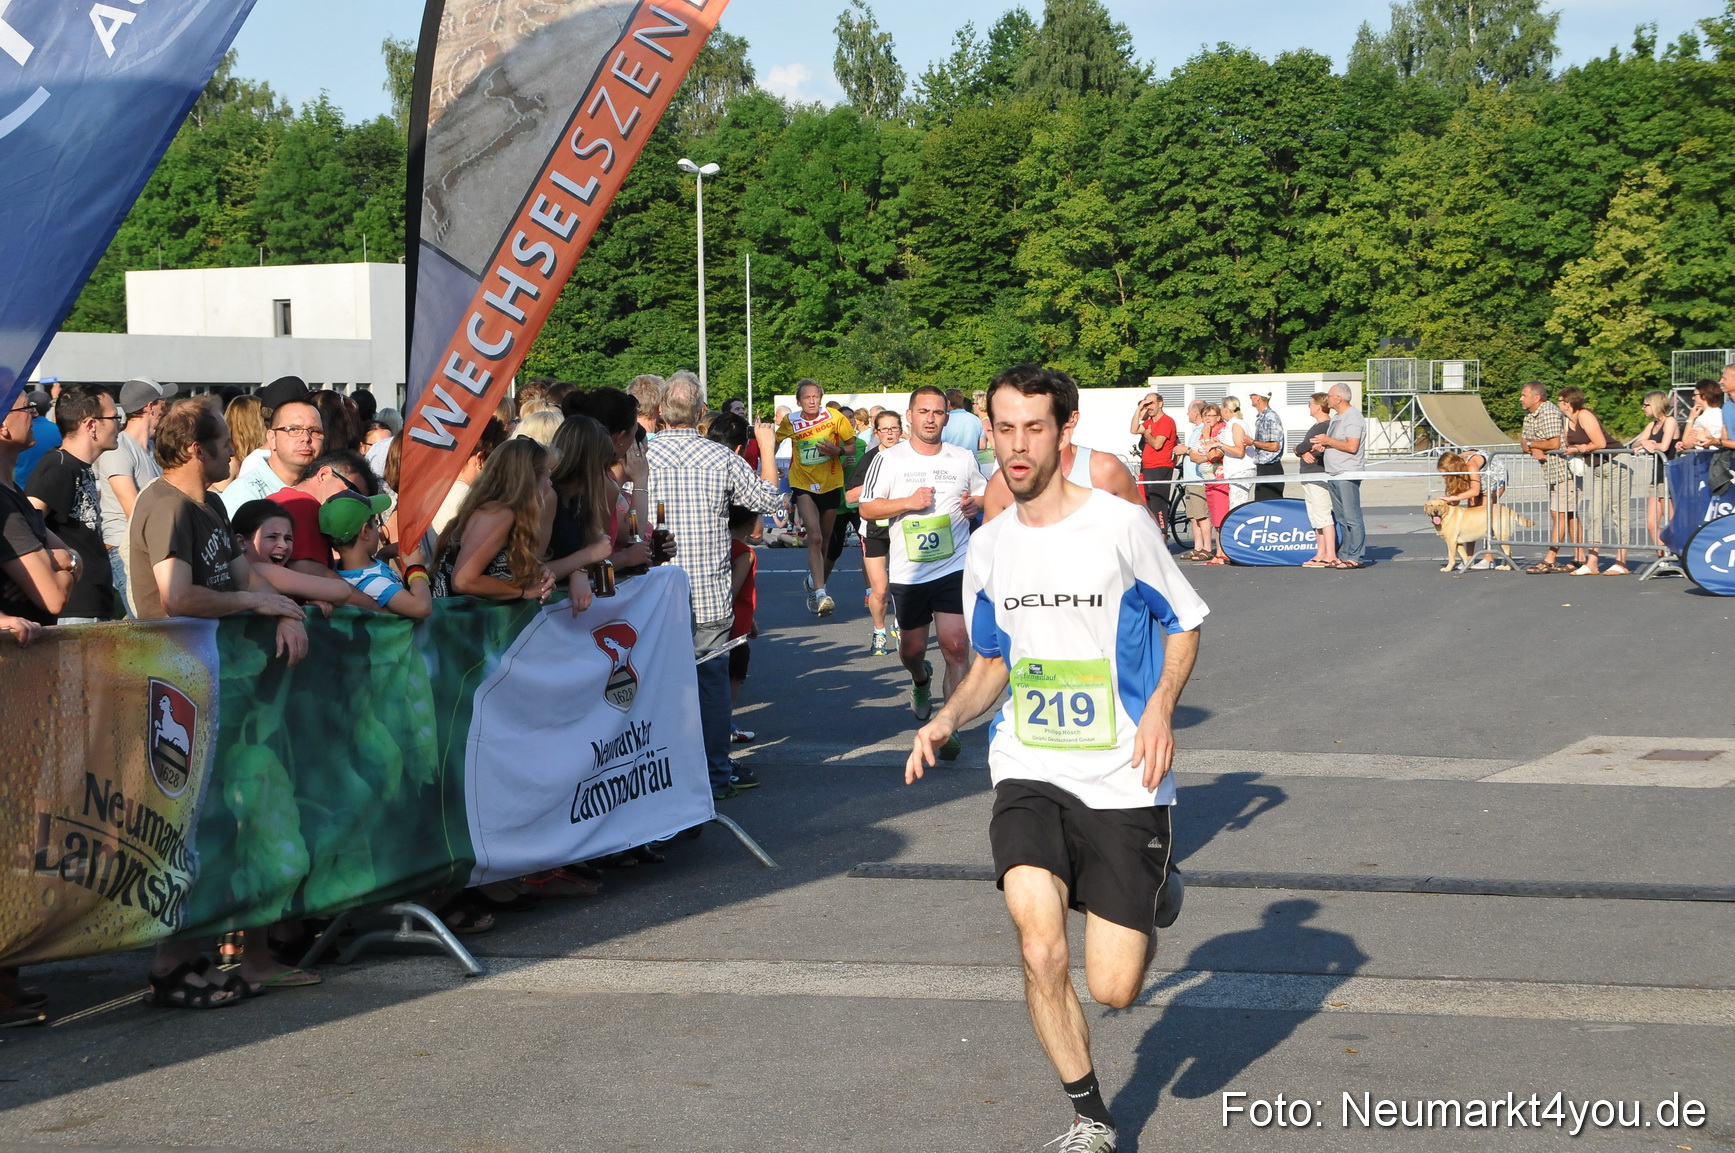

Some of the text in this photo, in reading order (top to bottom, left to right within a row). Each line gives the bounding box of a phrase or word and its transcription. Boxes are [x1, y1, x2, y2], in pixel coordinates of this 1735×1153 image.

[795, 430, 814, 441] MAX
[916, 532, 940, 550] 29
[1250, 527, 1316, 544] Fische
[1257, 543, 1318, 551] AUTOMOBIL
[1004, 593, 1103, 611] DELPHI
[612, 687, 634, 705] 1628
[1026, 690, 1095, 727] 219
[158, 763, 181, 790] 1628
[83, 771, 195, 877] Neumarkte
